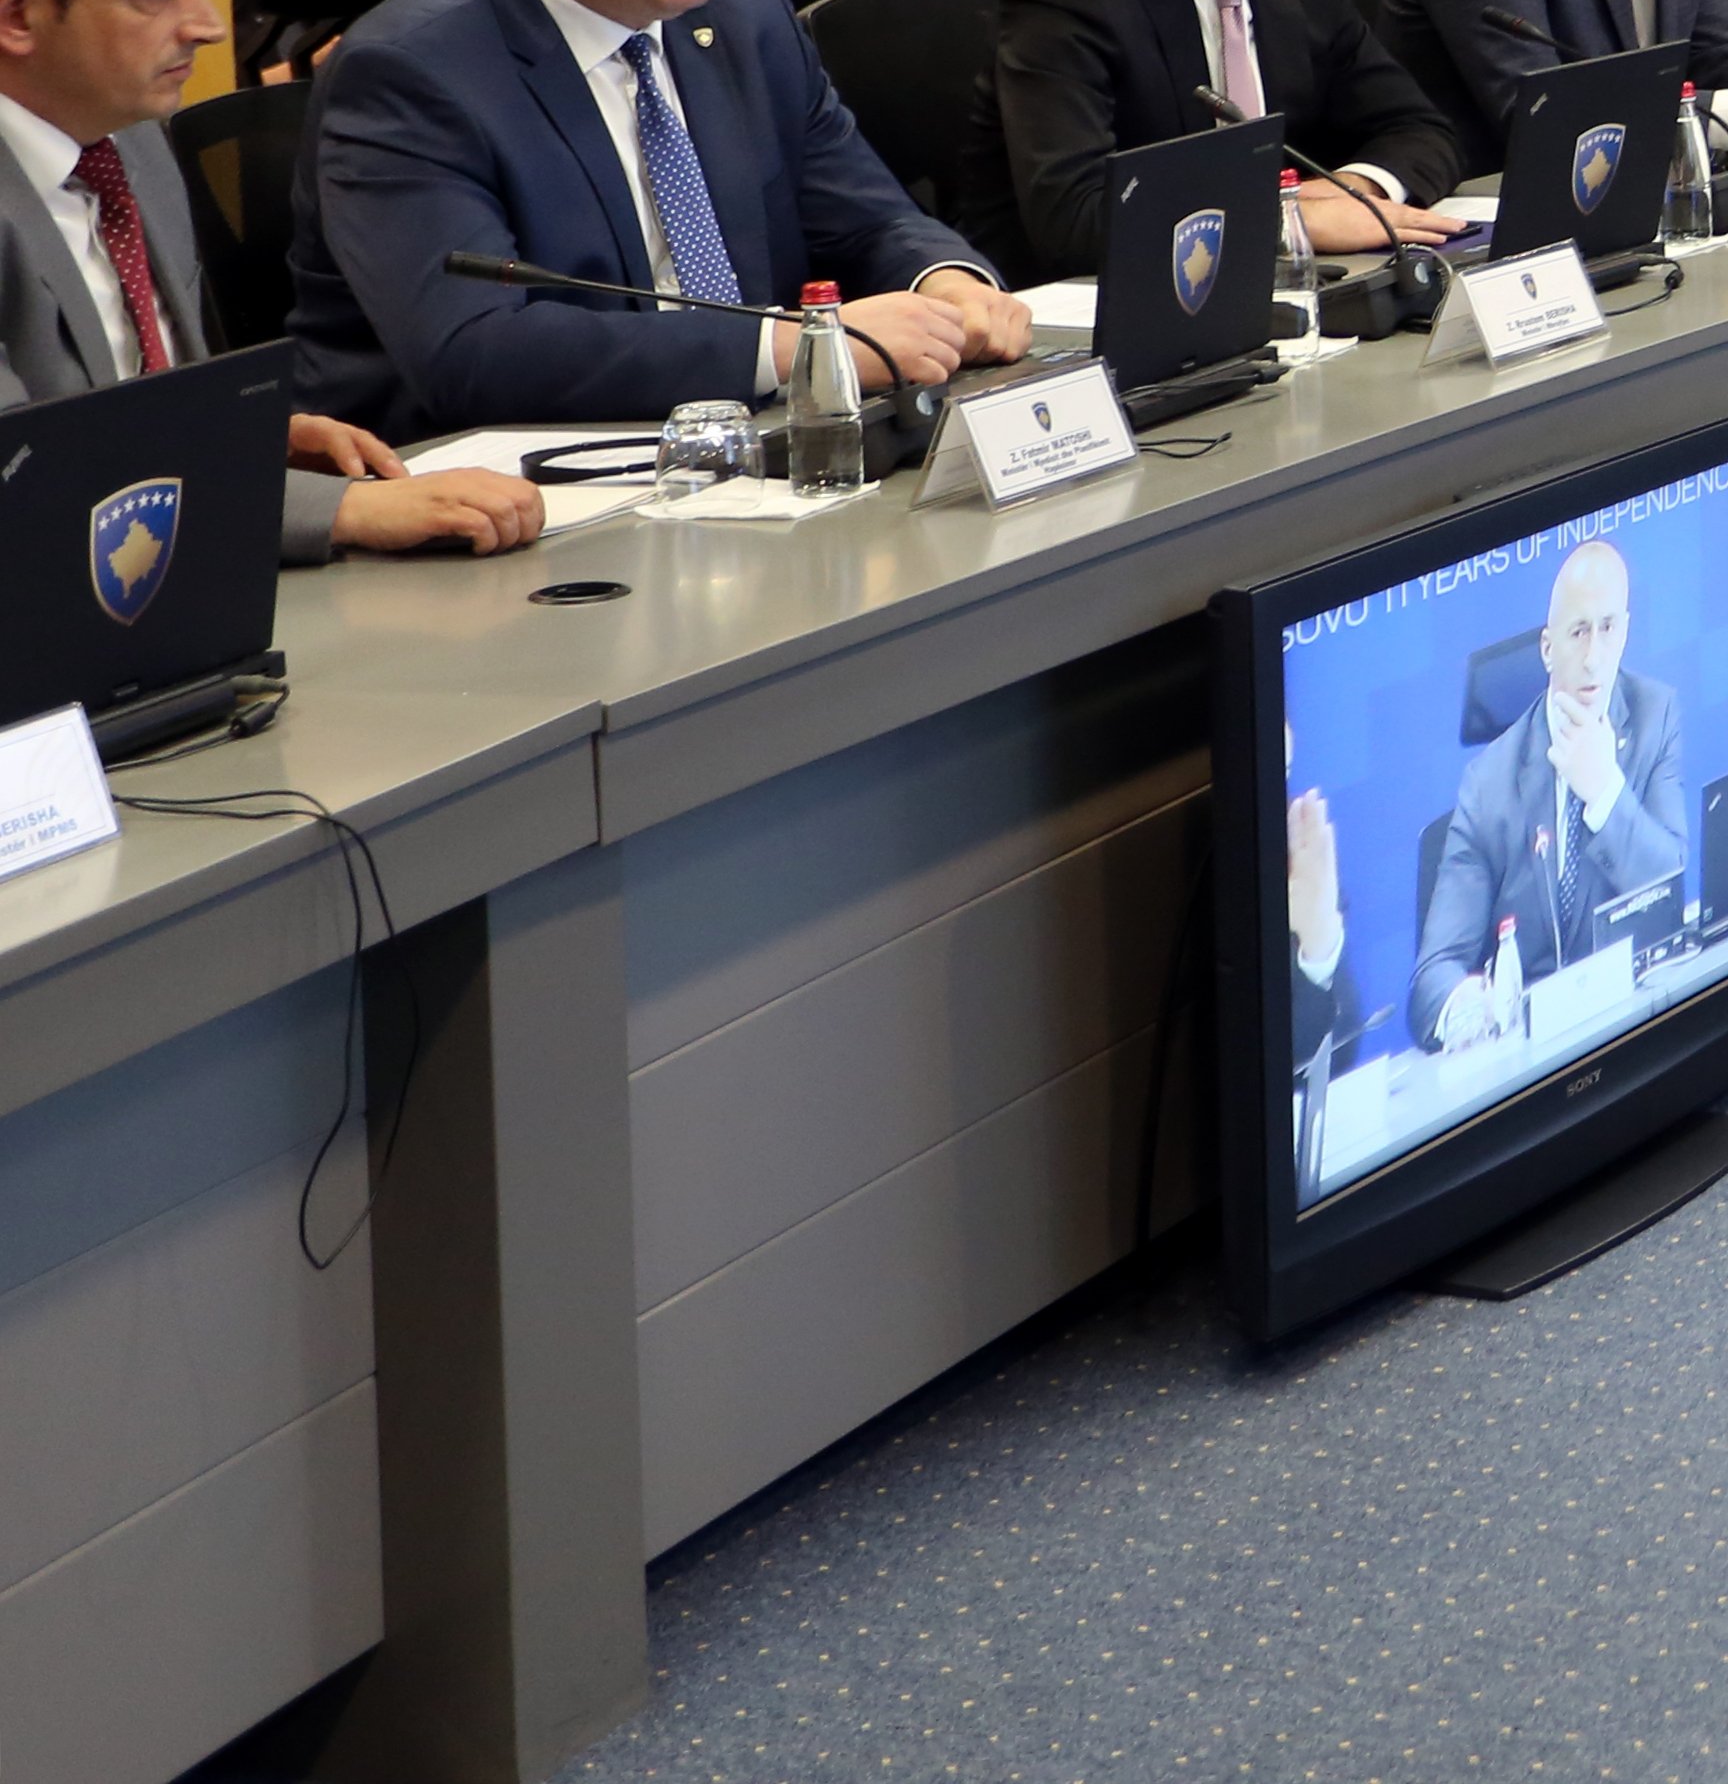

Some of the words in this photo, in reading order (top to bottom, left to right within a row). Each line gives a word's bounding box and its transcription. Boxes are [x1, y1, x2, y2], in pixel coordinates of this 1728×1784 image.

[1417, 549, 1510, 601] YEARS
[1516, 531, 1550, 565] OF
[0, 804, 61, 837] ERISHA
[1566, 1067, 1603, 1097] SONY
